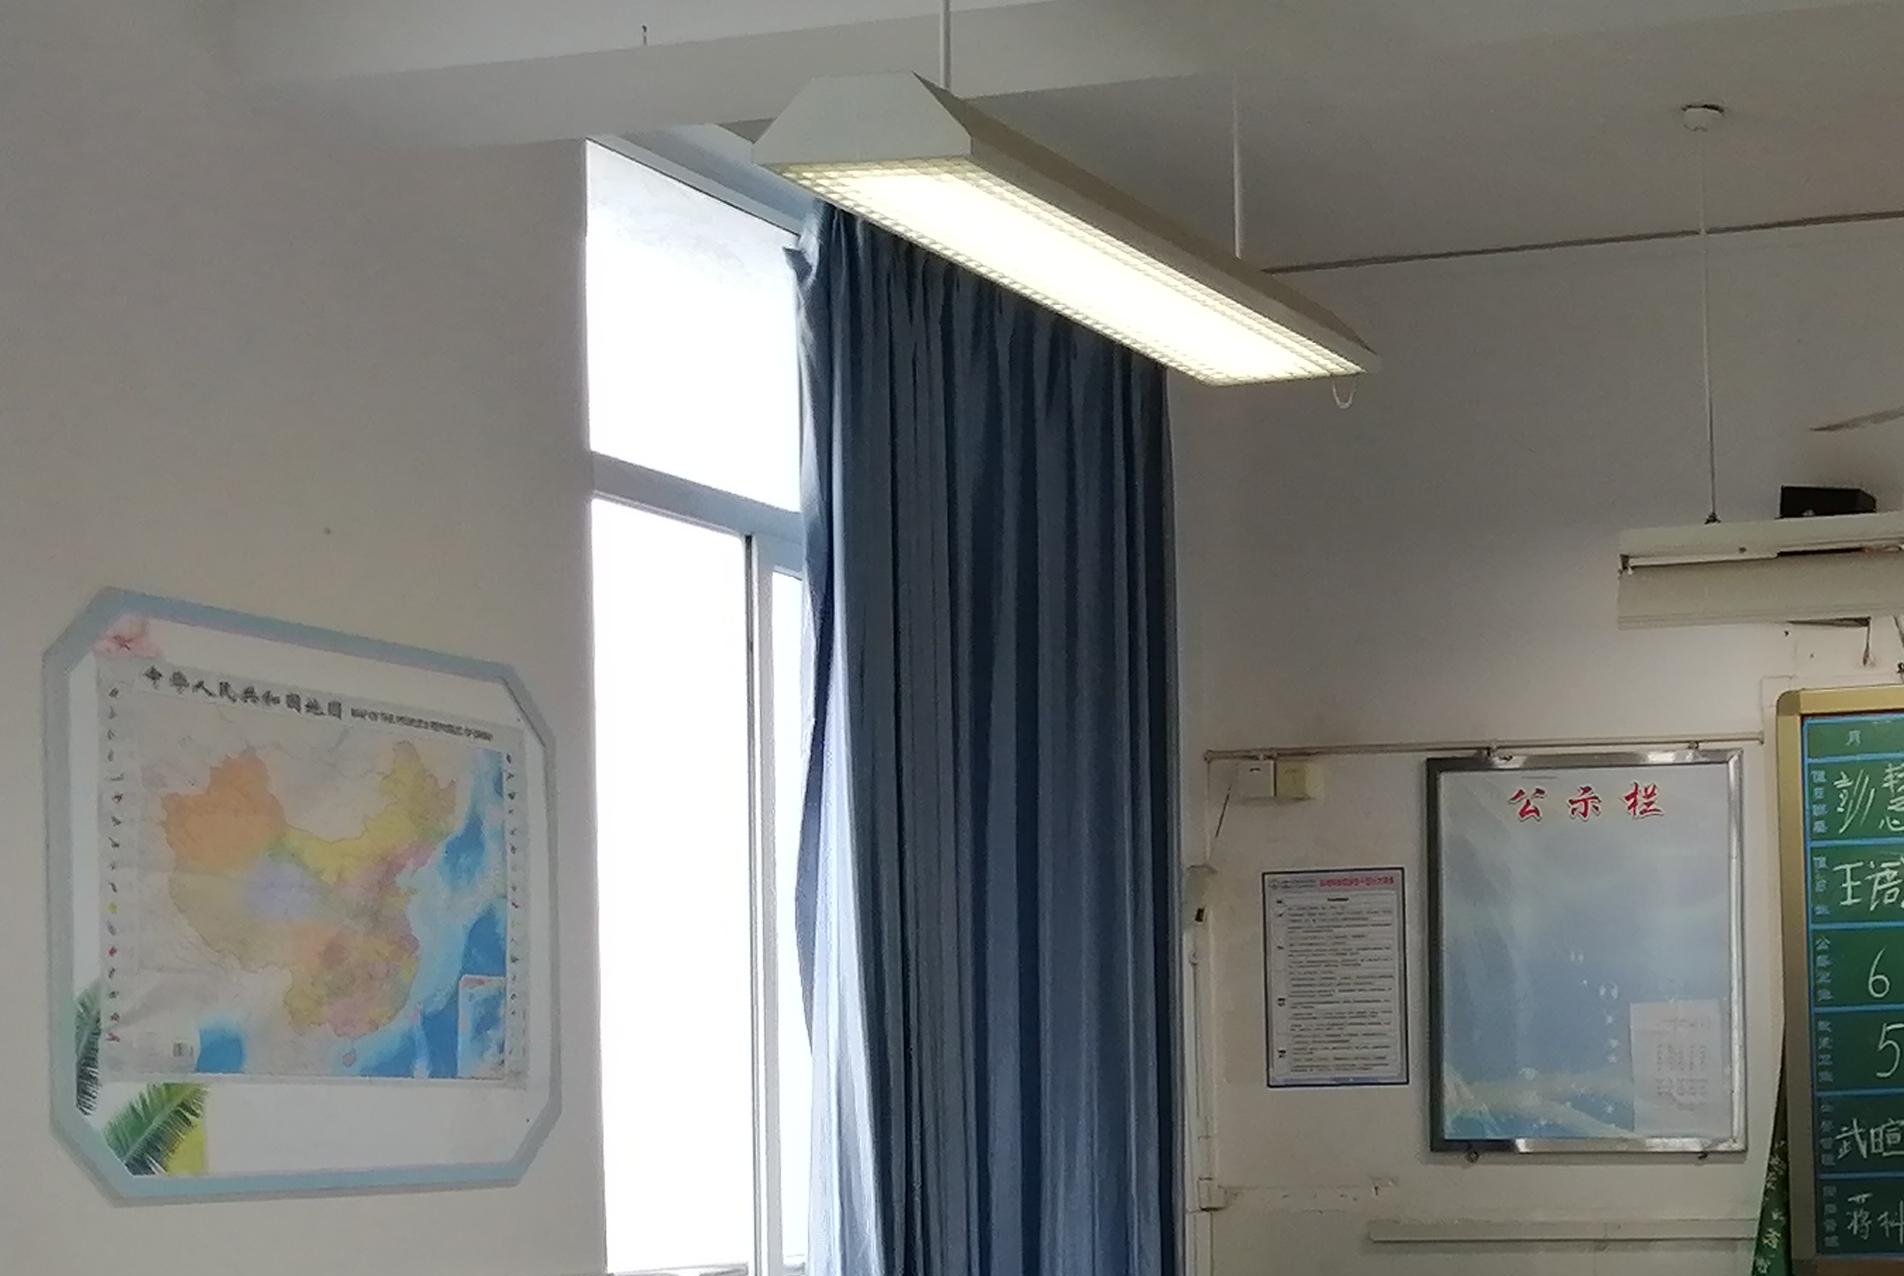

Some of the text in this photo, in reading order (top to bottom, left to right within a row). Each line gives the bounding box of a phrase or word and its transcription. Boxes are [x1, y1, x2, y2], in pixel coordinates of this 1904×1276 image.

[1509, 781, 1663, 822] 公示栏
[1868, 947, 1891, 998] 6
